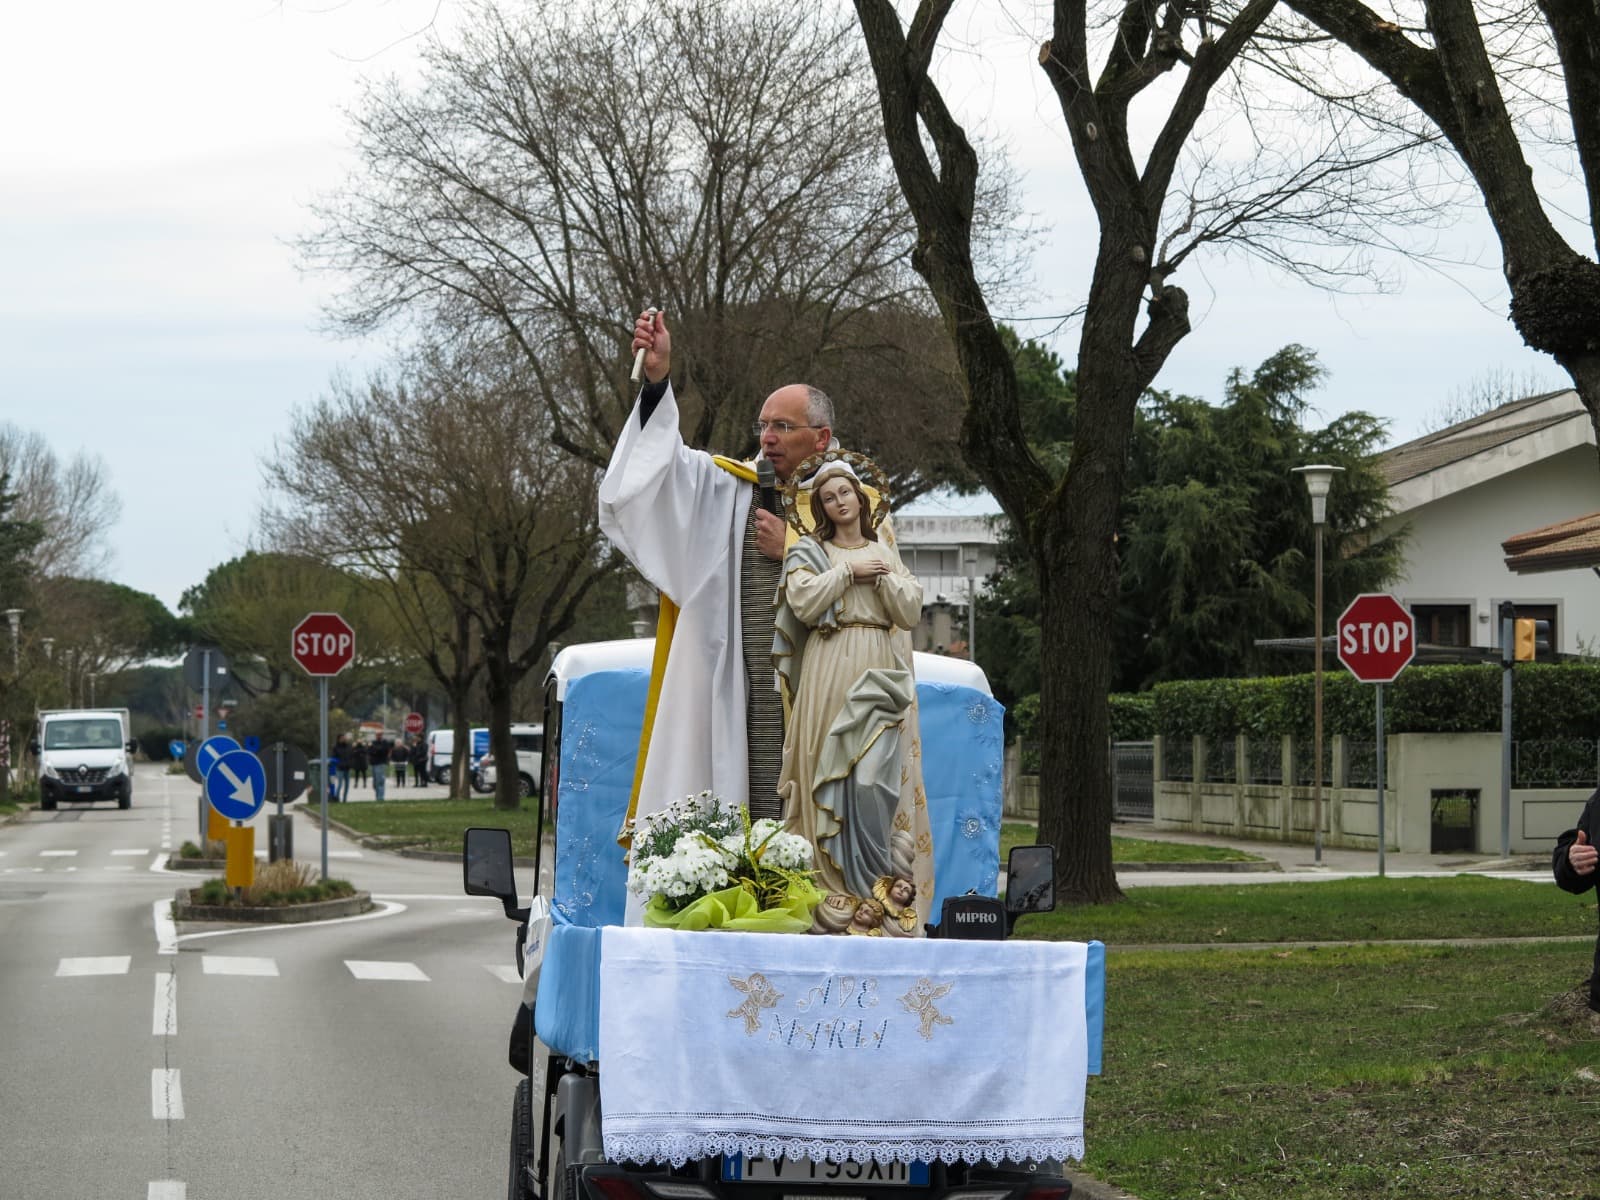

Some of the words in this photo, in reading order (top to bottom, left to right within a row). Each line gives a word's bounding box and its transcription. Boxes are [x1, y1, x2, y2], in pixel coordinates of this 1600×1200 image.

[297, 632, 351, 656] STOP
[1342, 621, 1409, 655] STOP
[955, 911, 998, 924] MIPRO
[797, 973, 880, 1013] AVE
[768, 1012, 893, 1050] MARIA
